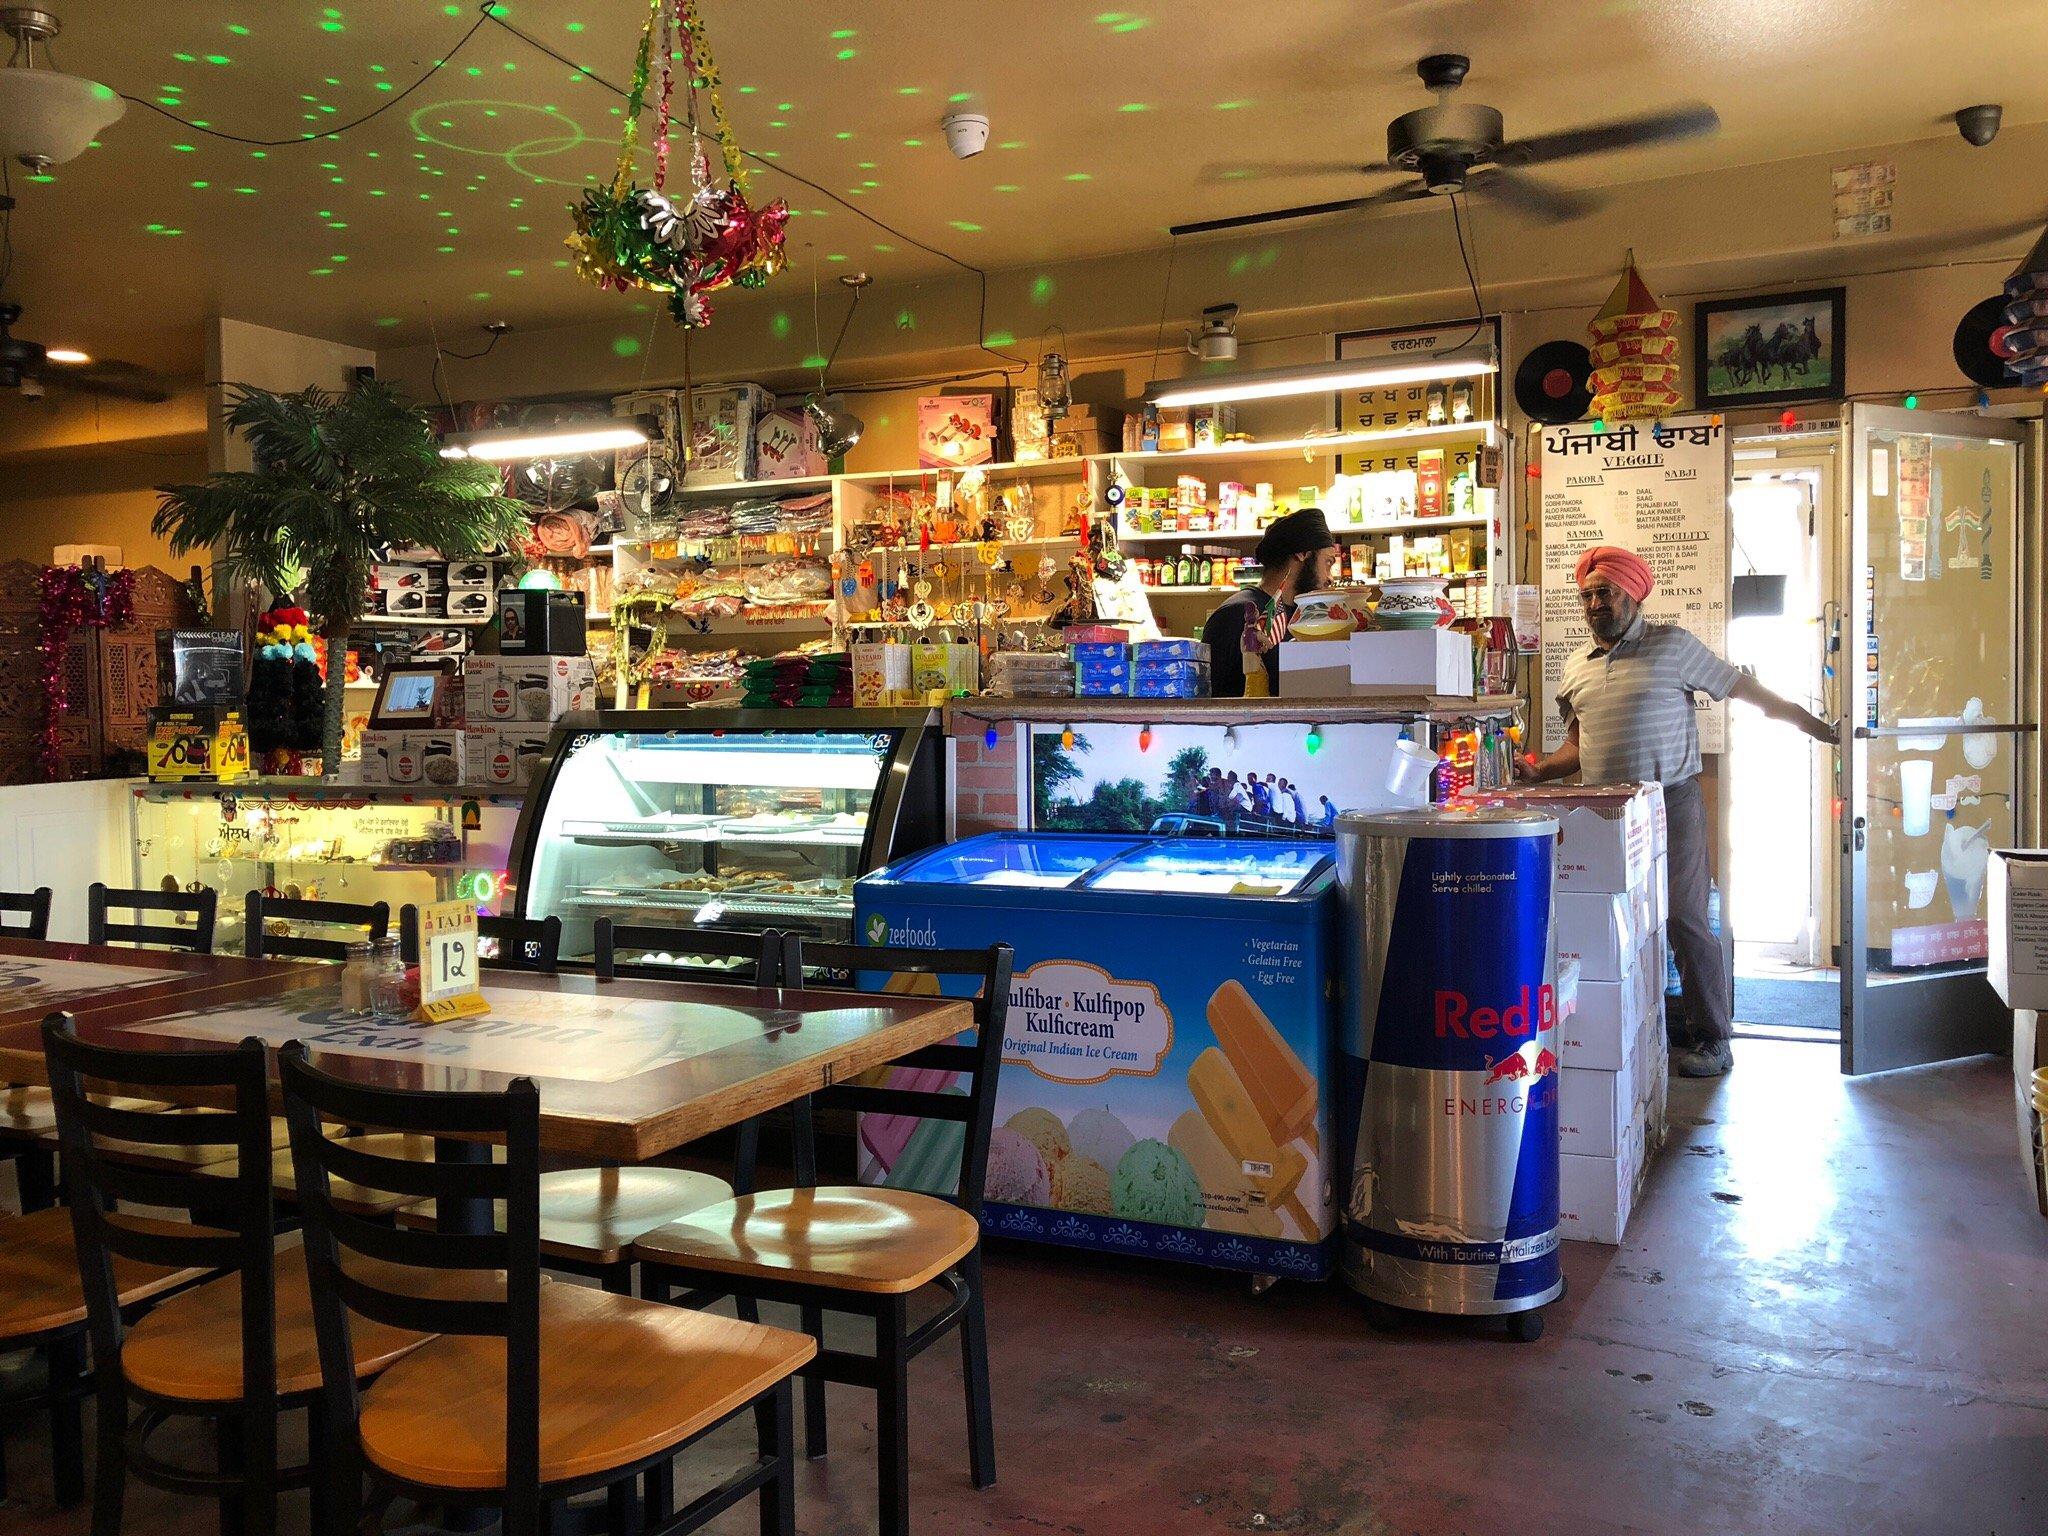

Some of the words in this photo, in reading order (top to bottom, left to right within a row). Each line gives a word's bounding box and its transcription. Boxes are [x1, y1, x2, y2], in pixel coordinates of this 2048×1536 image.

[1391, 336, 1437, 350] ਵਰਣਮਾਲਾ
[1359, 392, 1375, 404] ਕ
[1407, 386, 1424, 400] ਗ
[1768, 424, 1782, 433] THIS
[1808, 422, 1816, 430] TO
[1820, 420, 1840, 430] REMAI
[1546, 424, 1638, 456] ਪੰਜਾਬੀ
[1652, 425, 1722, 448] ਢਾਬਾ
[1603, 454, 1664, 467] VEGGIE
[1566, 474, 1604, 485] PAKORA
[1664, 469, 1697, 479] SABJI
[1566, 530, 1604, 538] SAMOSA
[1652, 531, 1710, 540] SPECILITY
[1661, 587, 1702, 596] DRINKS
[1867, 641, 1878, 649] ISA
[465, 660, 495, 668] Hawkins
[466, 724, 496, 734] Hawkins
[362, 734, 388, 742] Hawkins
[1432, 872, 1462, 883] Lightly
[1465, 871, 1518, 881] carbonated.
[1432, 884, 1458, 892] Serve
[1462, 884, 1494, 893] chilled.
[436, 914, 460, 928] TAJ
[889, 917, 936, 947] zeefoods
[1252, 938, 1298, 952] Vegetarian
[442, 941, 466, 982] 12
[1248, 954, 1280, 966] Gelatin
[1283, 956, 1302, 968] Free
[1258, 971, 1274, 986] Egg
[1276, 972, 1294, 984] Free
[426, 1000, 456, 1013] TAJ
[1008, 987, 1062, 1010] ulfibar
[1073, 992, 1145, 1022] Kulfipop
[1434, 985, 1530, 1039] Red
[1026, 1012, 1114, 1038] Kulficream
[1004, 1038, 1047, 1057] Original
[1048, 1042, 1083, 1058] Indian
[1086, 1046, 1101, 1058] Ice
[1103, 1048, 1138, 1062] Cream
[1444, 1097, 1524, 1116] ENERG
[1418, 1244, 1448, 1260] With
[1452, 1248, 1498, 1260] Taurine.
[1504, 1243, 1544, 1258] Vitalizes
